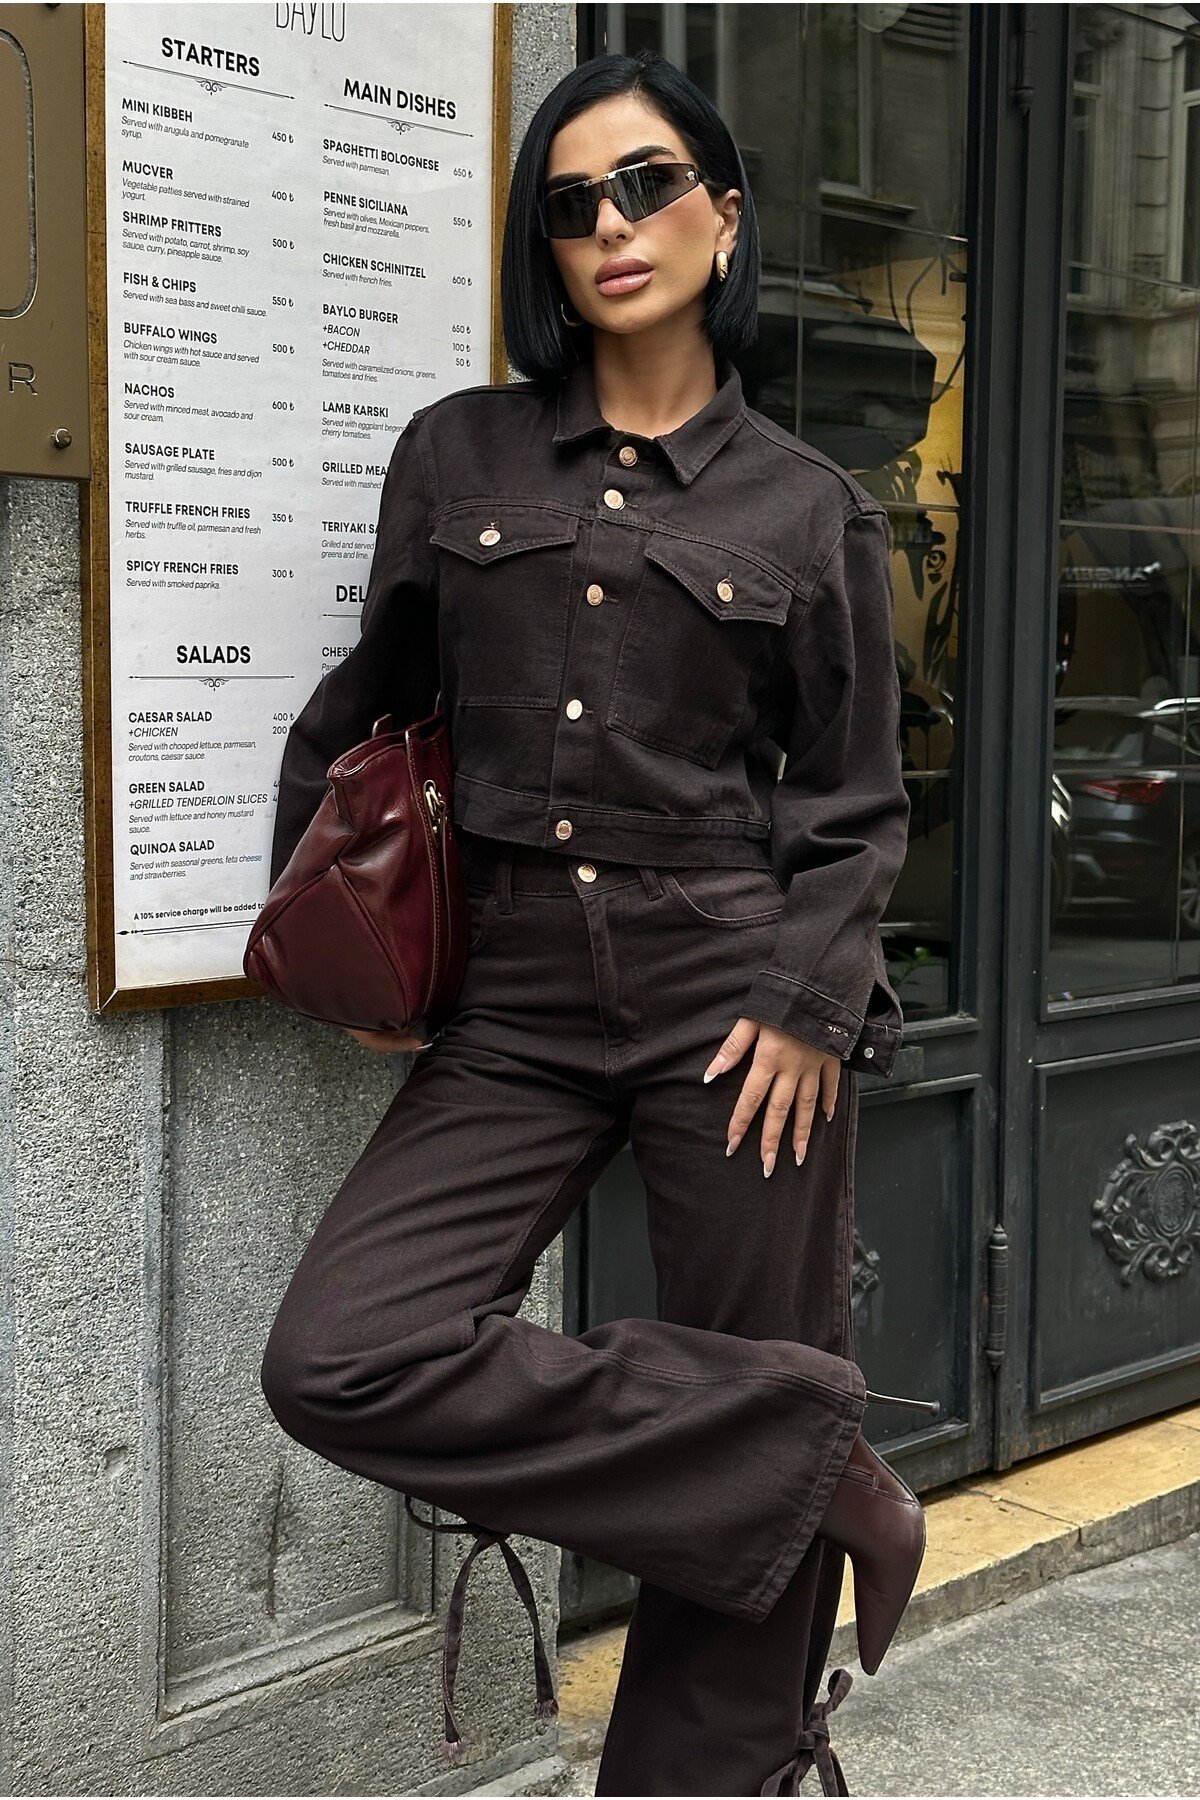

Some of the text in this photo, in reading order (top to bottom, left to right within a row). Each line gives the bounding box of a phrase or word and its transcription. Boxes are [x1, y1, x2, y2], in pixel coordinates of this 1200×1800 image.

[162, 37, 259, 76] STARTERS
[343, 79, 456, 119] MAIN DISHES
[122, 98, 193, 122] MINI KIBBEH
[122, 116, 249, 148] Served with arugula and pomegranate
[272, 131, 287, 142] 450
[323, 139, 440, 171] SPAGHETTI BOLOGNESE
[122, 160, 173, 179] MUCVER
[322, 156, 345, 167] Served
[346, 161, 359, 170] with
[453, 168, 466, 177] 650
[272, 190, 287, 201] 400
[323, 191, 408, 216] PENNE SICILIANA
[123, 211, 222, 237] SHRIMP FRITTERS
[453, 217, 466, 226] 550
[122, 229, 148, 240] Served
[149, 234, 163, 242] with
[237, 248, 249, 257] soy
[272, 239, 287, 248] 500
[323, 253, 426, 278] CHICKEN SCHINITZEL
[123, 272, 197, 292] FISH & CHIPS
[322, 269, 345, 280] Served
[345, 273, 358, 282] with
[359, 275, 378, 285] french
[452, 276, 466, 286] 600
[272, 297, 287, 306] 550
[323, 304, 399, 324] BAYLO BURGER
[124, 322, 217, 344] BUFFALO WINGS
[323, 325, 360, 337] +BACON
[452, 325, 465, 334] 650
[123, 340, 260, 363] Chicken wings with hot sauce and served
[272, 344, 287, 353] 500
[322, 341, 370, 354] +CHEDDAR
[452, 343, 465, 352] 100
[123, 352, 138, 360] with
[139, 354, 155, 362] sour
[156, 356, 179, 365] cream
[455, 359, 465, 367] 50
[8, 362, 37, 396] R
[124, 383, 175, 398] NACHOS
[124, 400, 149, 410] Served
[150, 403, 165, 411] with
[165, 404, 190, 414] minced
[211, 409, 239, 418] avocado
[240, 412, 253, 420] and
[272, 401, 287, 410] 600
[323, 402, 389, 417] LAMB KARSKI
[322, 429, 342, 439] cherry
[125, 443, 215, 460] SAUSAGE PLATE
[125, 460, 150, 469] Served
[151, 462, 165, 470] with
[166, 463, 187, 473] grilled
[218, 467, 232, 475] fries
[233, 468, 246, 476] and
[247, 469, 262, 479] dijon
[272, 458, 287, 467] 500
[322, 462, 389, 476] GRILLED MEA
[125, 501, 250, 519] TRUFFLE FRENCH FRIES
[272, 513, 287, 522] 350
[125, 519, 150, 528] Served
[151, 520, 166, 529] with
[167, 521, 186, 530] truffle
[197, 524, 230, 533] parmesan
[231, 525, 244, 533] and
[244, 525, 261, 534] fresh
[322, 521, 366, 533] TERIYAKI
[321, 540, 342, 548] Grilled
[342, 541, 353, 549] and
[321, 552, 342, 560] greens
[126, 560, 239, 575] SPICY FRENCH FRIES
[272, 570, 287, 578] 300
[126, 578, 151, 587] Served
[152, 579, 166, 587] with
[167, 580, 194, 588] smoked
[176, 645, 251, 664] SALADS
[128, 711, 213, 723] CAESAR SALAD
[273, 712, 288, 721] 400
[128, 727, 178, 737] +CHICKEN
[272, 726, 287, 734] 200
[129, 781, 205, 794] GREEN SALAD
[128, 798, 174, 810] +GRILLED
[177, 795, 235, 807] TENDERLOIN
[236, 794, 268, 804] SLICES
[128, 809, 254, 824] Served with lettuce and honey mustard
[130, 840, 215, 855] QUINOA SALAD
[130, 872, 143, 880] and
[140, 912, 154, 920] 10%
[155, 910, 182, 918] service
[183, 908, 208, 916] charge
[209, 906, 222, 914] will
[223, 905, 232, 913] be
[233, 903, 257, 912] added
